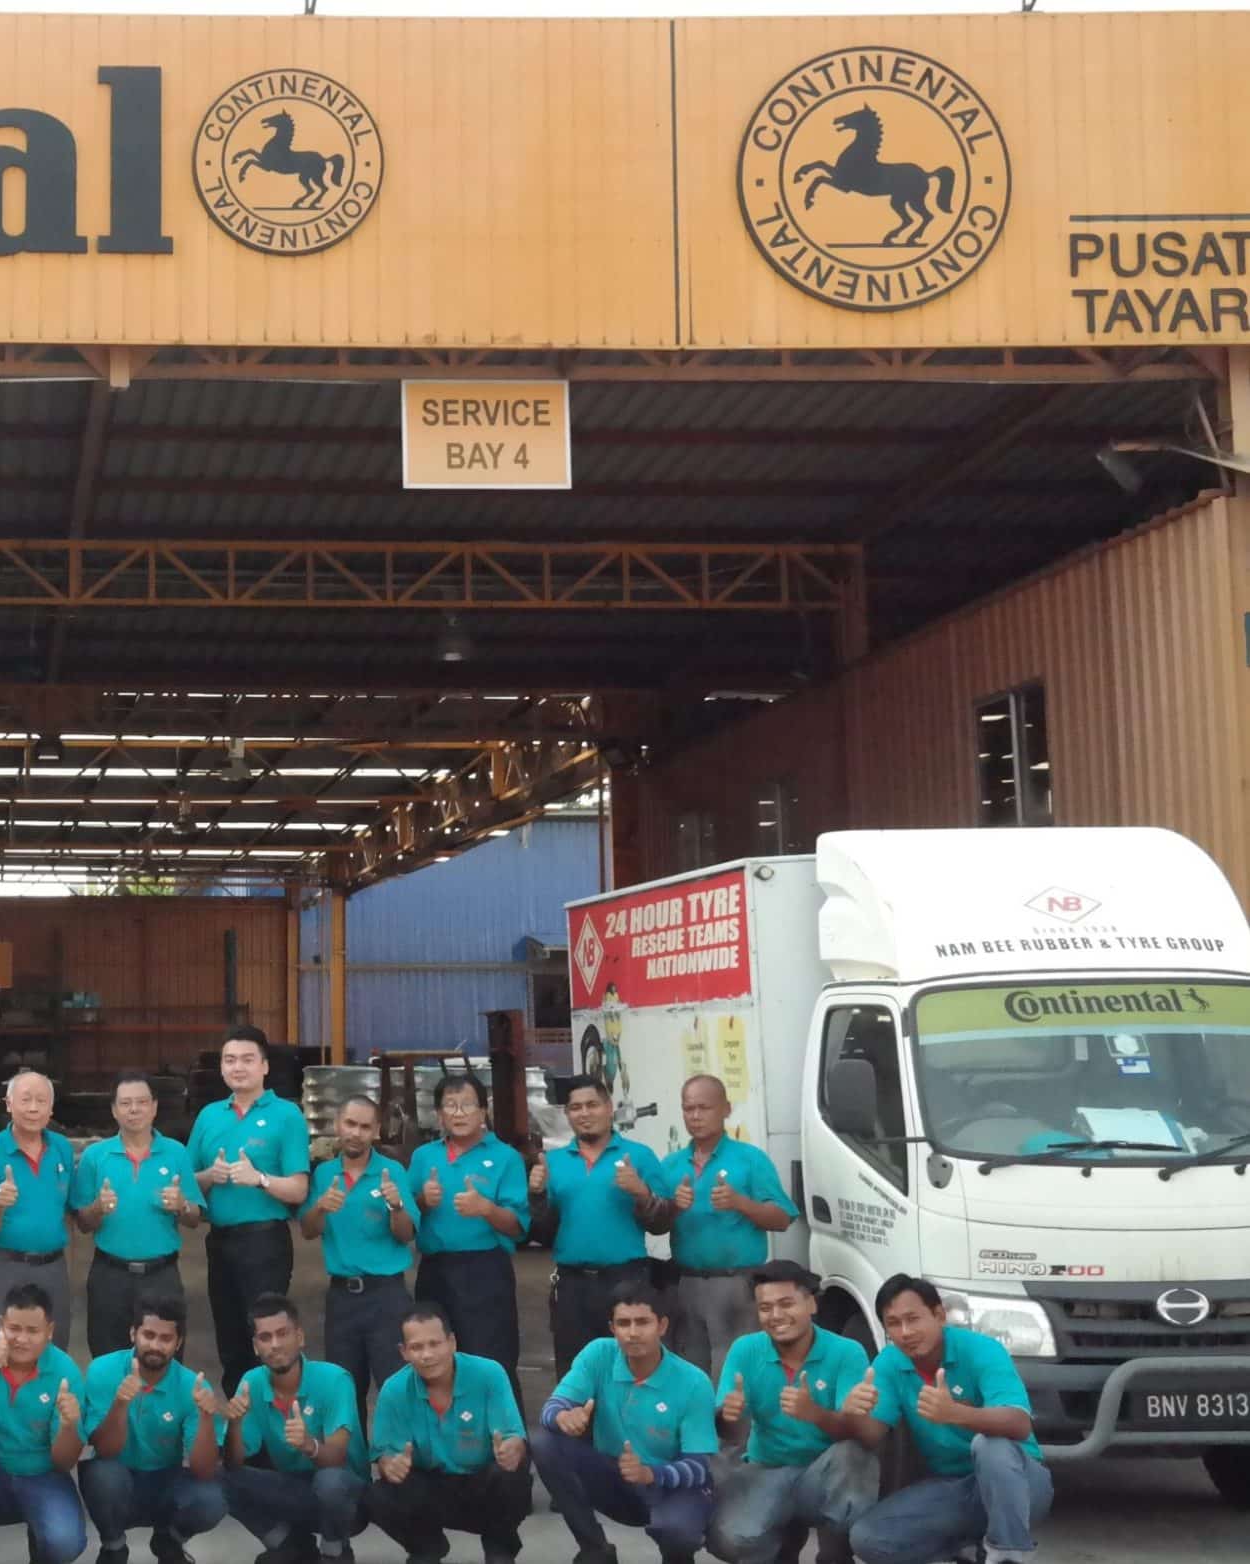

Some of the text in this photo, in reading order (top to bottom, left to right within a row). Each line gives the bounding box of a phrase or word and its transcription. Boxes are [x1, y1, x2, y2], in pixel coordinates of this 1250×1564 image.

[204, 74, 372, 146] CONTINENTAL
[752, 54, 993, 155] CONTINENTAL
[204, 175, 374, 248] CONTINENTAL
[756, 201, 998, 302] CONTINENTAL
[1069, 231, 1250, 278] PUSAT
[1071, 287, 1250, 334] TAYAR
[421, 398, 551, 427] SERVICE
[446, 442, 530, 470] BAY 4
[605, 883, 741, 939] 24 HOUR TYRE
[1047, 896, 1082, 912] NB
[631, 918, 740, 958] RESCUE TEAMS
[935, 936, 1225, 958] NAM BEE RUBBER & TYRE GROUP
[646, 945, 740, 980] NATIONWIDE
[1004, 988, 1186, 1023] Continental
[978, 1262, 1047, 1276] HINO
[1147, 1392, 1250, 1418] BNV 8313
